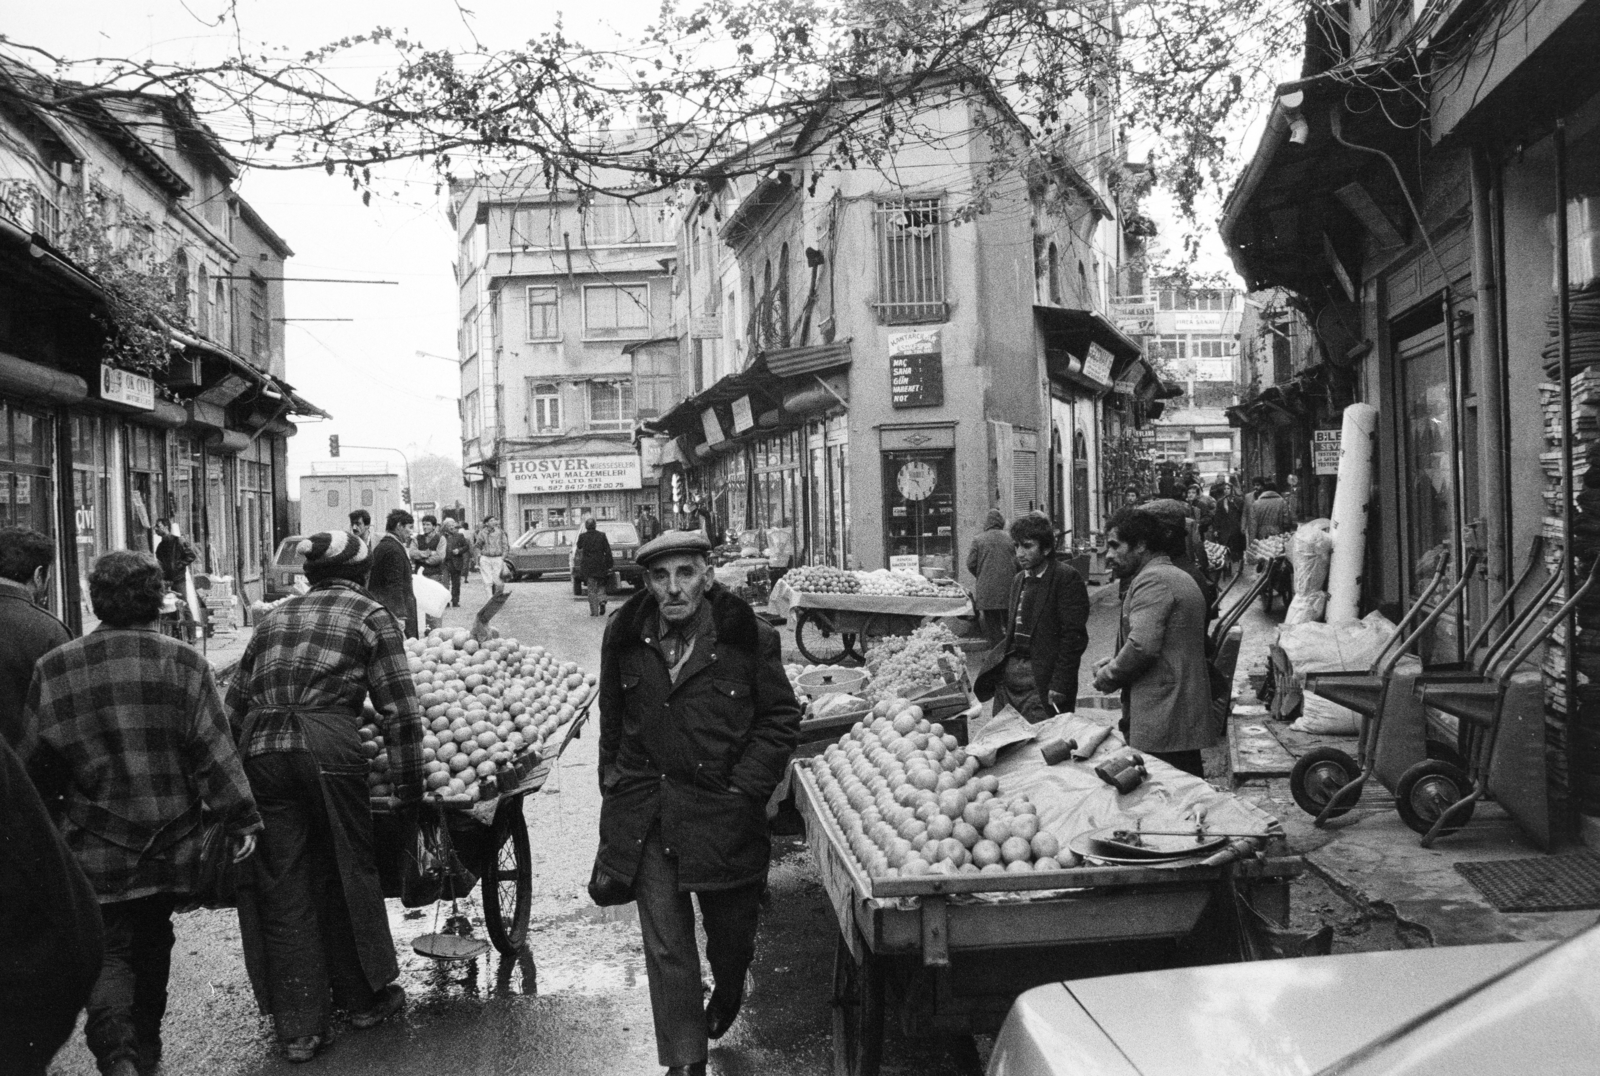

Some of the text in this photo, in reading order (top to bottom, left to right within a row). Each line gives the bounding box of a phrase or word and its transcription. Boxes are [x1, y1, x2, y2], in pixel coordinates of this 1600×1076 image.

[893, 395, 909, 403] NOT
[511, 459, 589, 473] HOSVER
[75, 504, 95, 534] çivi
